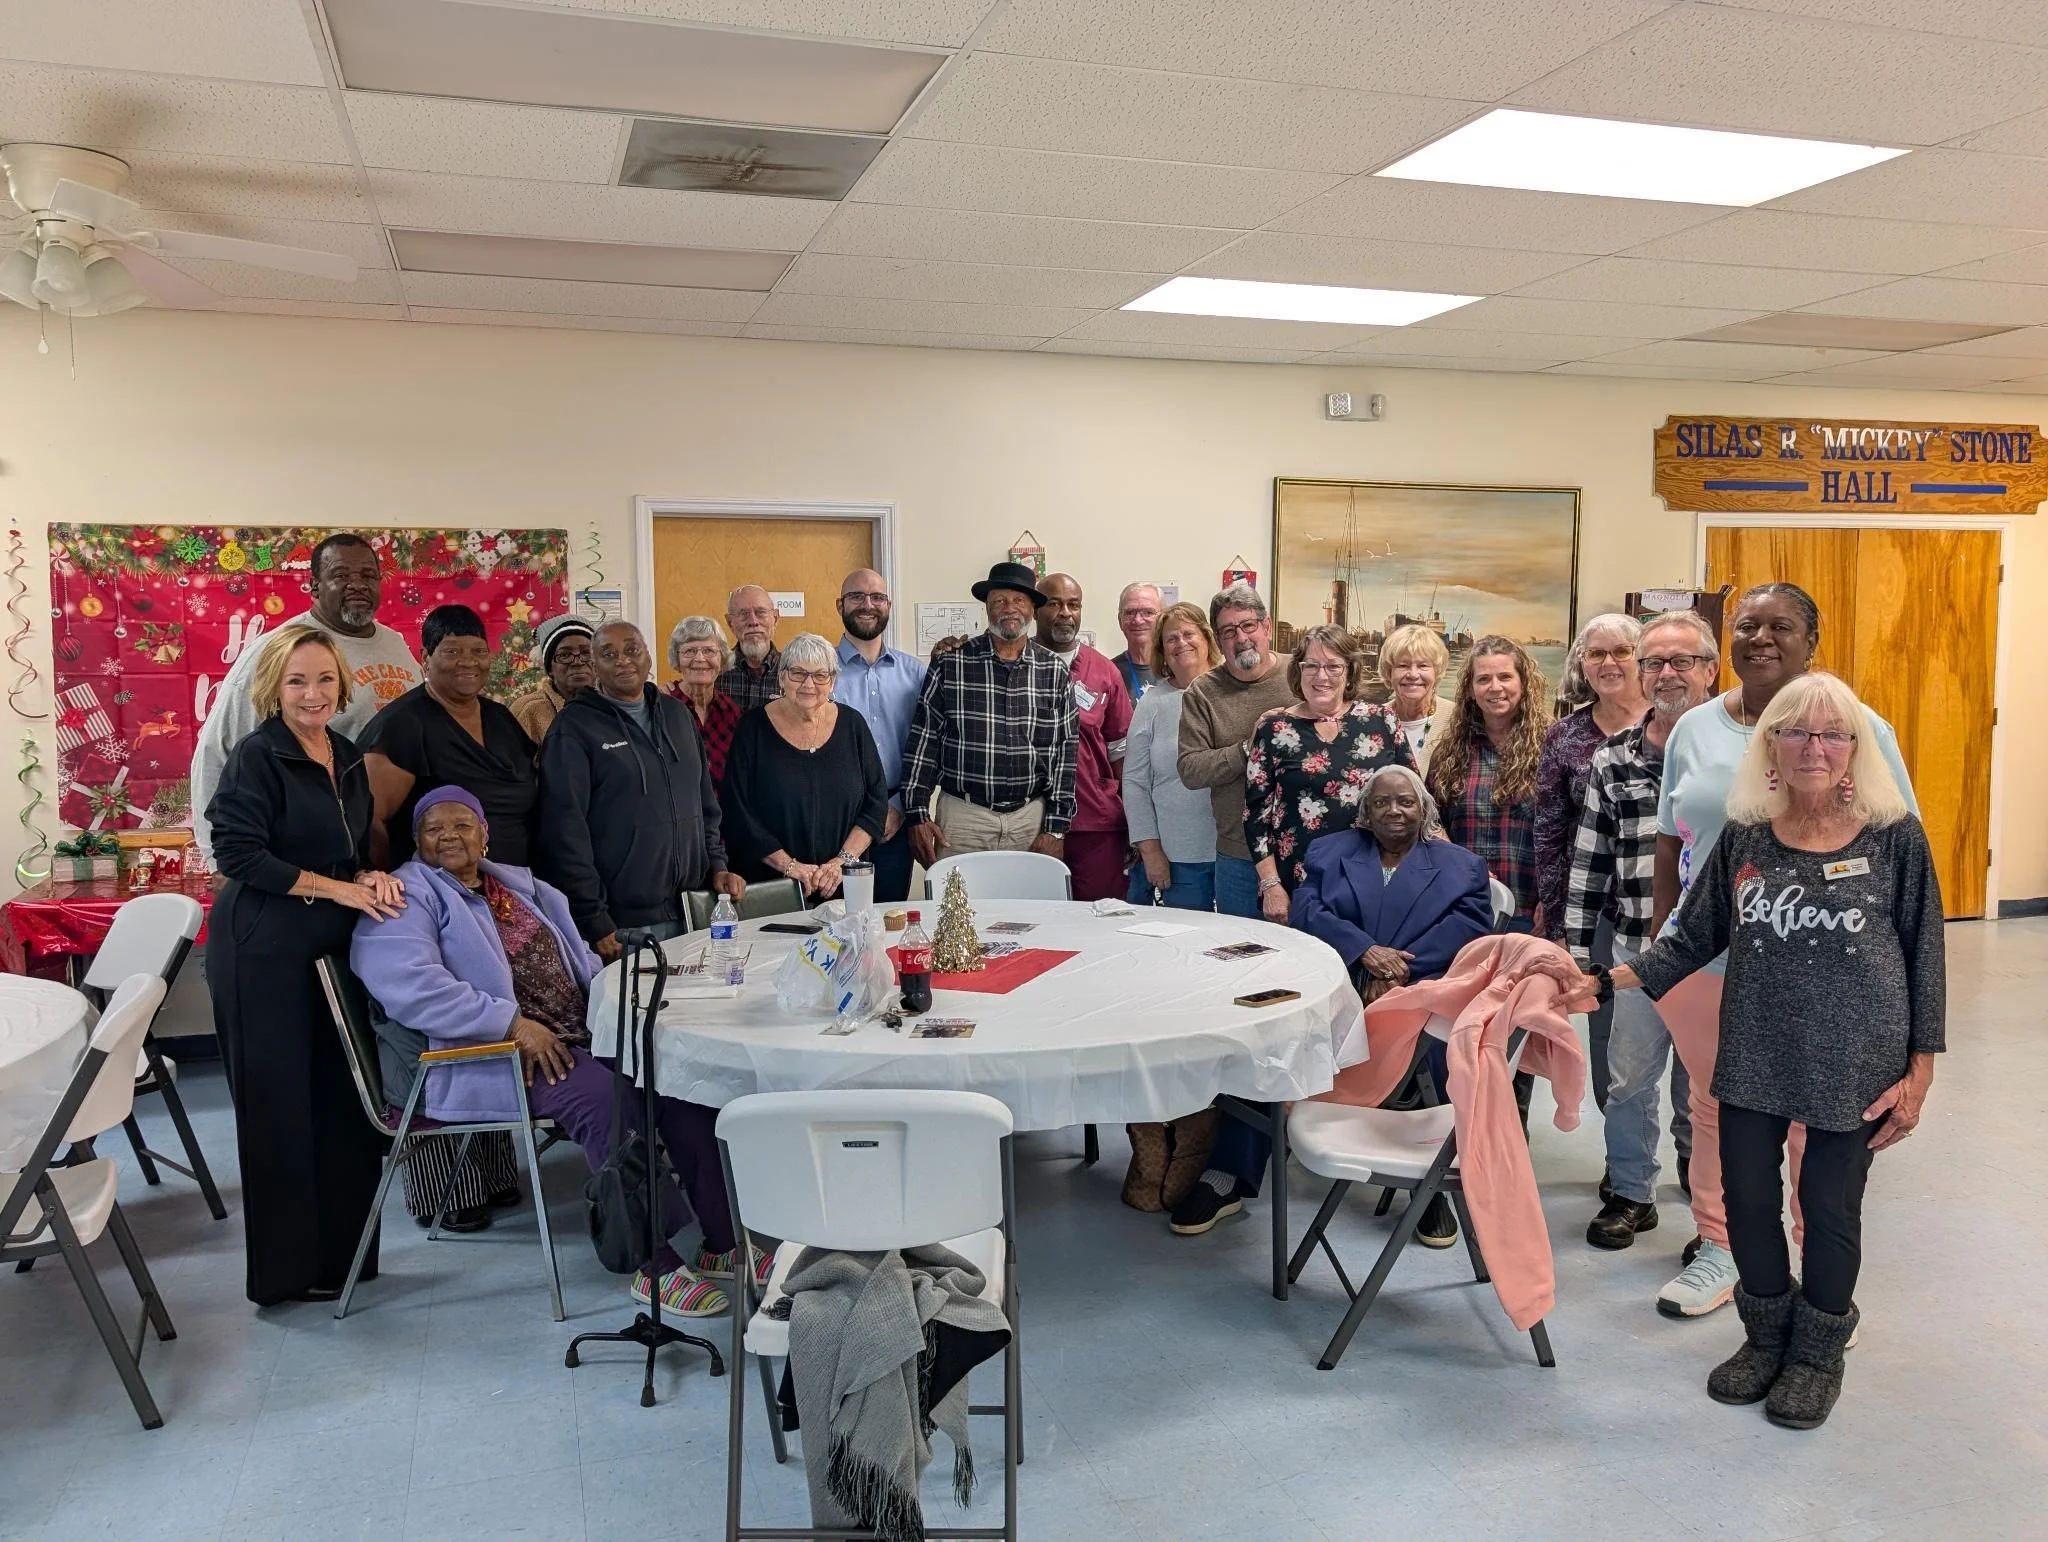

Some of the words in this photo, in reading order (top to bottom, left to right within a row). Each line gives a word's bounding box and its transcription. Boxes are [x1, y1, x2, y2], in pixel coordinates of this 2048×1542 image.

[1677, 424, 1763, 458] SILAS
[1778, 426, 1804, 459] R.
[1950, 431, 2032, 463] STONE
[1821, 471, 1897, 503] HALL
[1737, 885, 1866, 938] Believe
